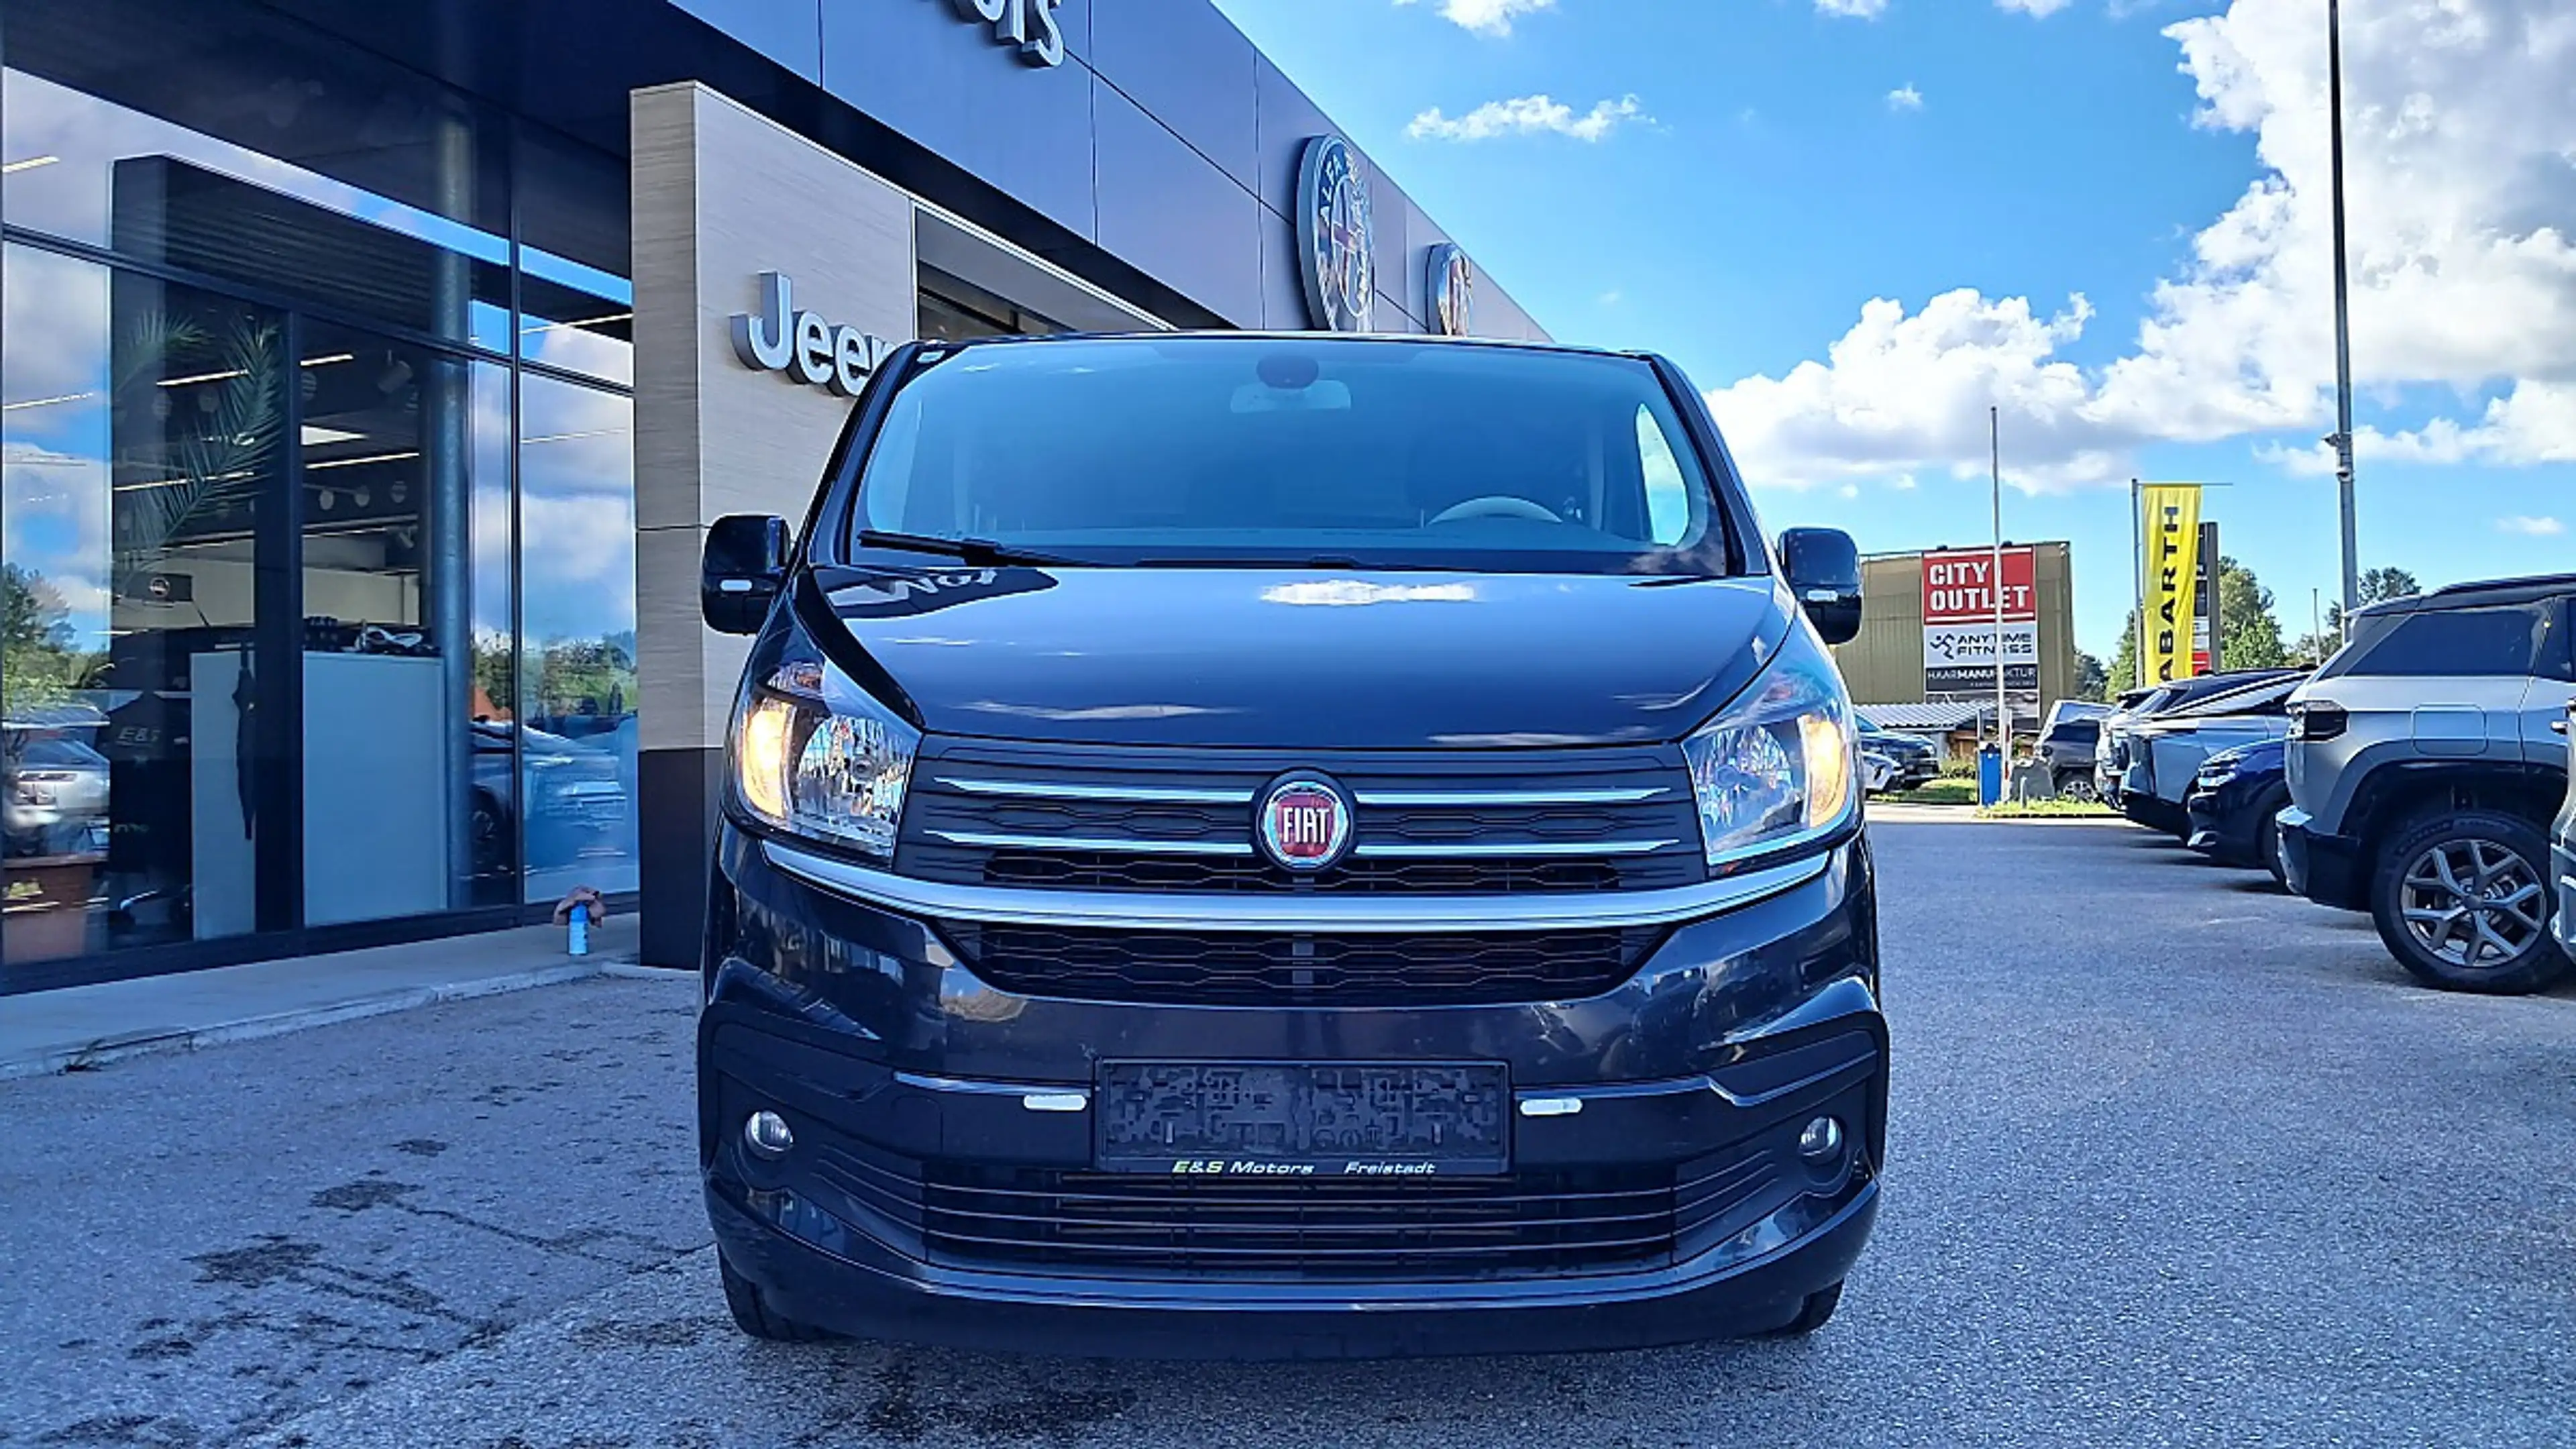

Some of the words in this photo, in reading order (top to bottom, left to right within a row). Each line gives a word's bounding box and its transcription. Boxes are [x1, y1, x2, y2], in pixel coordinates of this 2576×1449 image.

[1929, 561, 1989, 585] CITY
[1930, 586, 2029, 611] OUTLET
[2159, 506, 2178, 682] ABARTH
[1927, 667, 2036, 680] HAARMANUKTUR
[1283, 807, 1330, 843] FIAT
[1172, 1161, 1224, 1173] E&S
[1230, 1161, 1315, 1174] Motors
[1344, 1161, 1436, 1175] Freistadt
